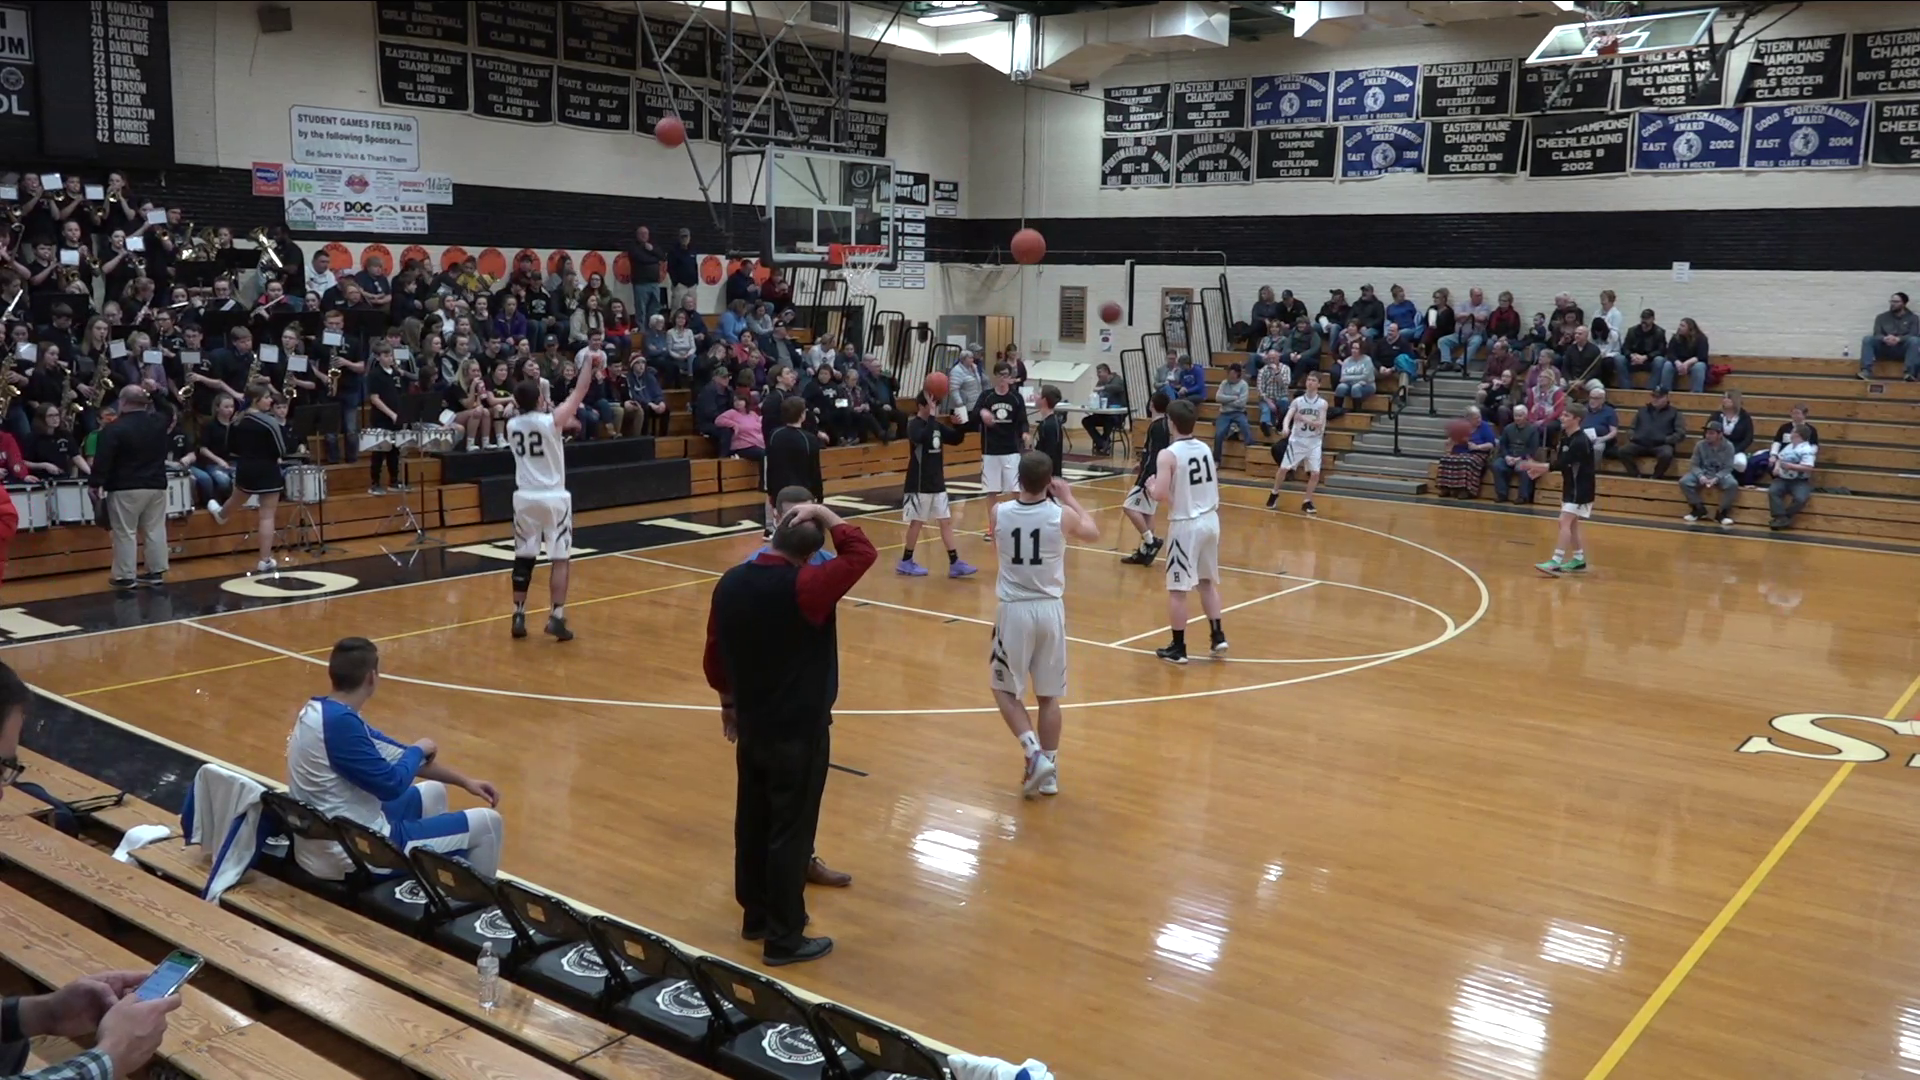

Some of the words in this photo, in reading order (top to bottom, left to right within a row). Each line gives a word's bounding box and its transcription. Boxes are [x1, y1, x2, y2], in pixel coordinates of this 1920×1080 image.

[92, 12, 103, 24] 11
[108, 14, 149, 30] SHEARER
[91, 26, 104, 37] 20
[108, 27, 149, 43] PLOURDE
[93, 38, 104, 51] 21
[109, 40, 149, 56] DARLING
[1797, 38, 1832, 50] MAINE
[93, 51, 105, 64] 22
[110, 53, 136, 67] FRIEL
[385, 47, 429, 61] EASTERN
[433, 52, 463, 65] MAINE
[93, 65, 106, 77] 23
[398, 60, 451, 75] CHAMPIONS
[475, 58, 517, 74] EASTERN
[522, 66, 550, 78] MAINE
[1424, 62, 1470, 76] EASTERN
[1472, 60, 1512, 74] MAINE
[1766, 66, 1805, 77] 2003
[488, 72, 538, 88] CHAMPIONS
[1336, 77, 1354, 93] GOOD
[1358, 68, 1414, 89] SPORTSMANSHIP
[1363, 77, 1387, 86] AWARD
[1436, 74, 1499, 88] CHAMPIONS
[1626, 76, 1653, 86] GIRLS
[1781, 75, 1823, 87] SOCCER
[1857, 71, 1886, 82] BOYS
[94, 78, 107, 90] 24
[111, 79, 147, 94] BENSON
[558, 77, 582, 90] STATE
[586, 82, 630, 96] CHAMPIONS
[1175, 81, 1215, 93] EASTERN
[1218, 79, 1247, 91] MAINE
[1254, 82, 1270, 99] GOOD
[1274, 74, 1326, 93] SPORTSMANSHIP
[1278, 82, 1301, 91] AWARD
[1643, 85, 1685, 96] CLASS
[95, 91, 108, 103] 25
[112, 92, 142, 106] CLARK
[405, 91, 435, 104] CLASS
[438, 95, 446, 104] B
[1185, 91, 1235, 103] CHAMPIONS
[1755, 87, 1799, 99] CLASS
[1802, 86, 1813, 96] C
[569, 95, 590, 106] BOYS
[598, 97, 618, 109] GOLF
[1256, 102, 1273, 110] EAST
[1338, 97, 1357, 106] EAST
[1436, 96, 1495, 107] CHEERLEADING
[1652, 96, 1686, 106] 2002
[95, 104, 108, 116] 32
[113, 105, 155, 120] DUNSTAN
[494, 103, 523, 117] CLASS
[565, 108, 591, 120] CLASS
[1187, 112, 1205, 120] GIRLS
[1447, 107, 1472, 116] CLASS
[1882, 105, 1919, 117] STATE
[96, 117, 109, 130] 33
[113, 118, 148, 132] MORRIS
[297, 113, 337, 125] STUDENT
[340, 118, 369, 128] GAMES
[371, 120, 391, 131] FEES
[393, 122, 412, 132] PAID
[1194, 120, 1214, 128] CLASS
[1641, 120, 1663, 137] GOOD
[1667, 111, 1740, 133] SPORTSMANSHIP
[1754, 112, 1780, 132] GOOD
[1783, 105, 1860, 128] SPORTSMANSHIP
[1792, 115, 1826, 125] AWARD
[1443, 121, 1482, 133] EASTERN
[1484, 121, 1512, 131] MAINE
[1673, 121, 1705, 132] AWARD
[97, 130, 109, 142] 42
[113, 131, 150, 145] GAMBLE
[298, 129, 308, 140] by
[310, 130, 324, 140] the
[326, 131, 363, 145] following
[1270, 131, 1302, 140] EASTERN
[1303, 130, 1324, 139] MAINE
[1345, 131, 1363, 148] GOOD
[1366, 124, 1423, 145] SPORTSMANSHIP
[1371, 132, 1395, 141] AWARD
[1445, 132, 1506, 144] CHAMPIONS
[1536, 133, 1623, 149] CHEERLEADING
[1278, 140, 1315, 149] CHAMPIONS
[1461, 144, 1489, 153] 2001
[1642, 142, 1667, 151] EAST
[1709, 140, 1735, 149] 2002
[1755, 139, 1781, 149] EAST
[1828, 137, 1854, 147] 2004
[305, 149, 314, 157] Be
[316, 150, 333, 158] Sure
[335, 151, 342, 159] to
[344, 152, 358, 160] Visit
[367, 154, 387, 162] Thank
[389, 155, 407, 163] Them
[1102, 146, 1148, 174] SPORTSMANSHIP
[1176, 143, 1228, 171] SPORTSMANSHIP
[1347, 153, 1366, 161] EAST
[1443, 152, 1503, 163] CHEERLEADING
[1552, 150, 1591, 161] CLASS
[1596, 149, 1605, 158] B
[1272, 159, 1319, 168] CHEERLEADING
[1449, 163, 1485, 172] CLASS
[1489, 163, 1497, 171] B
[1561, 162, 1594, 171] 2002
[1778, 159, 1799, 167] CLASS
[1810, 158, 1850, 166] BASKETBALL
[1181, 173, 1199, 183] GIRLS
[1206, 171, 1244, 183] BASKETBALL
[1280, 168, 1302, 177] CLASS
[1107, 175, 1122, 186] GIRLS
[1130, 173, 1164, 185] BASKETBALL
[288, 180, 313, 193] live
[320, 201, 341, 213] HPS
[512, 430, 545, 457] 32
[1188, 454, 1213, 486] 21
[1011, 527, 1042, 566] 11
